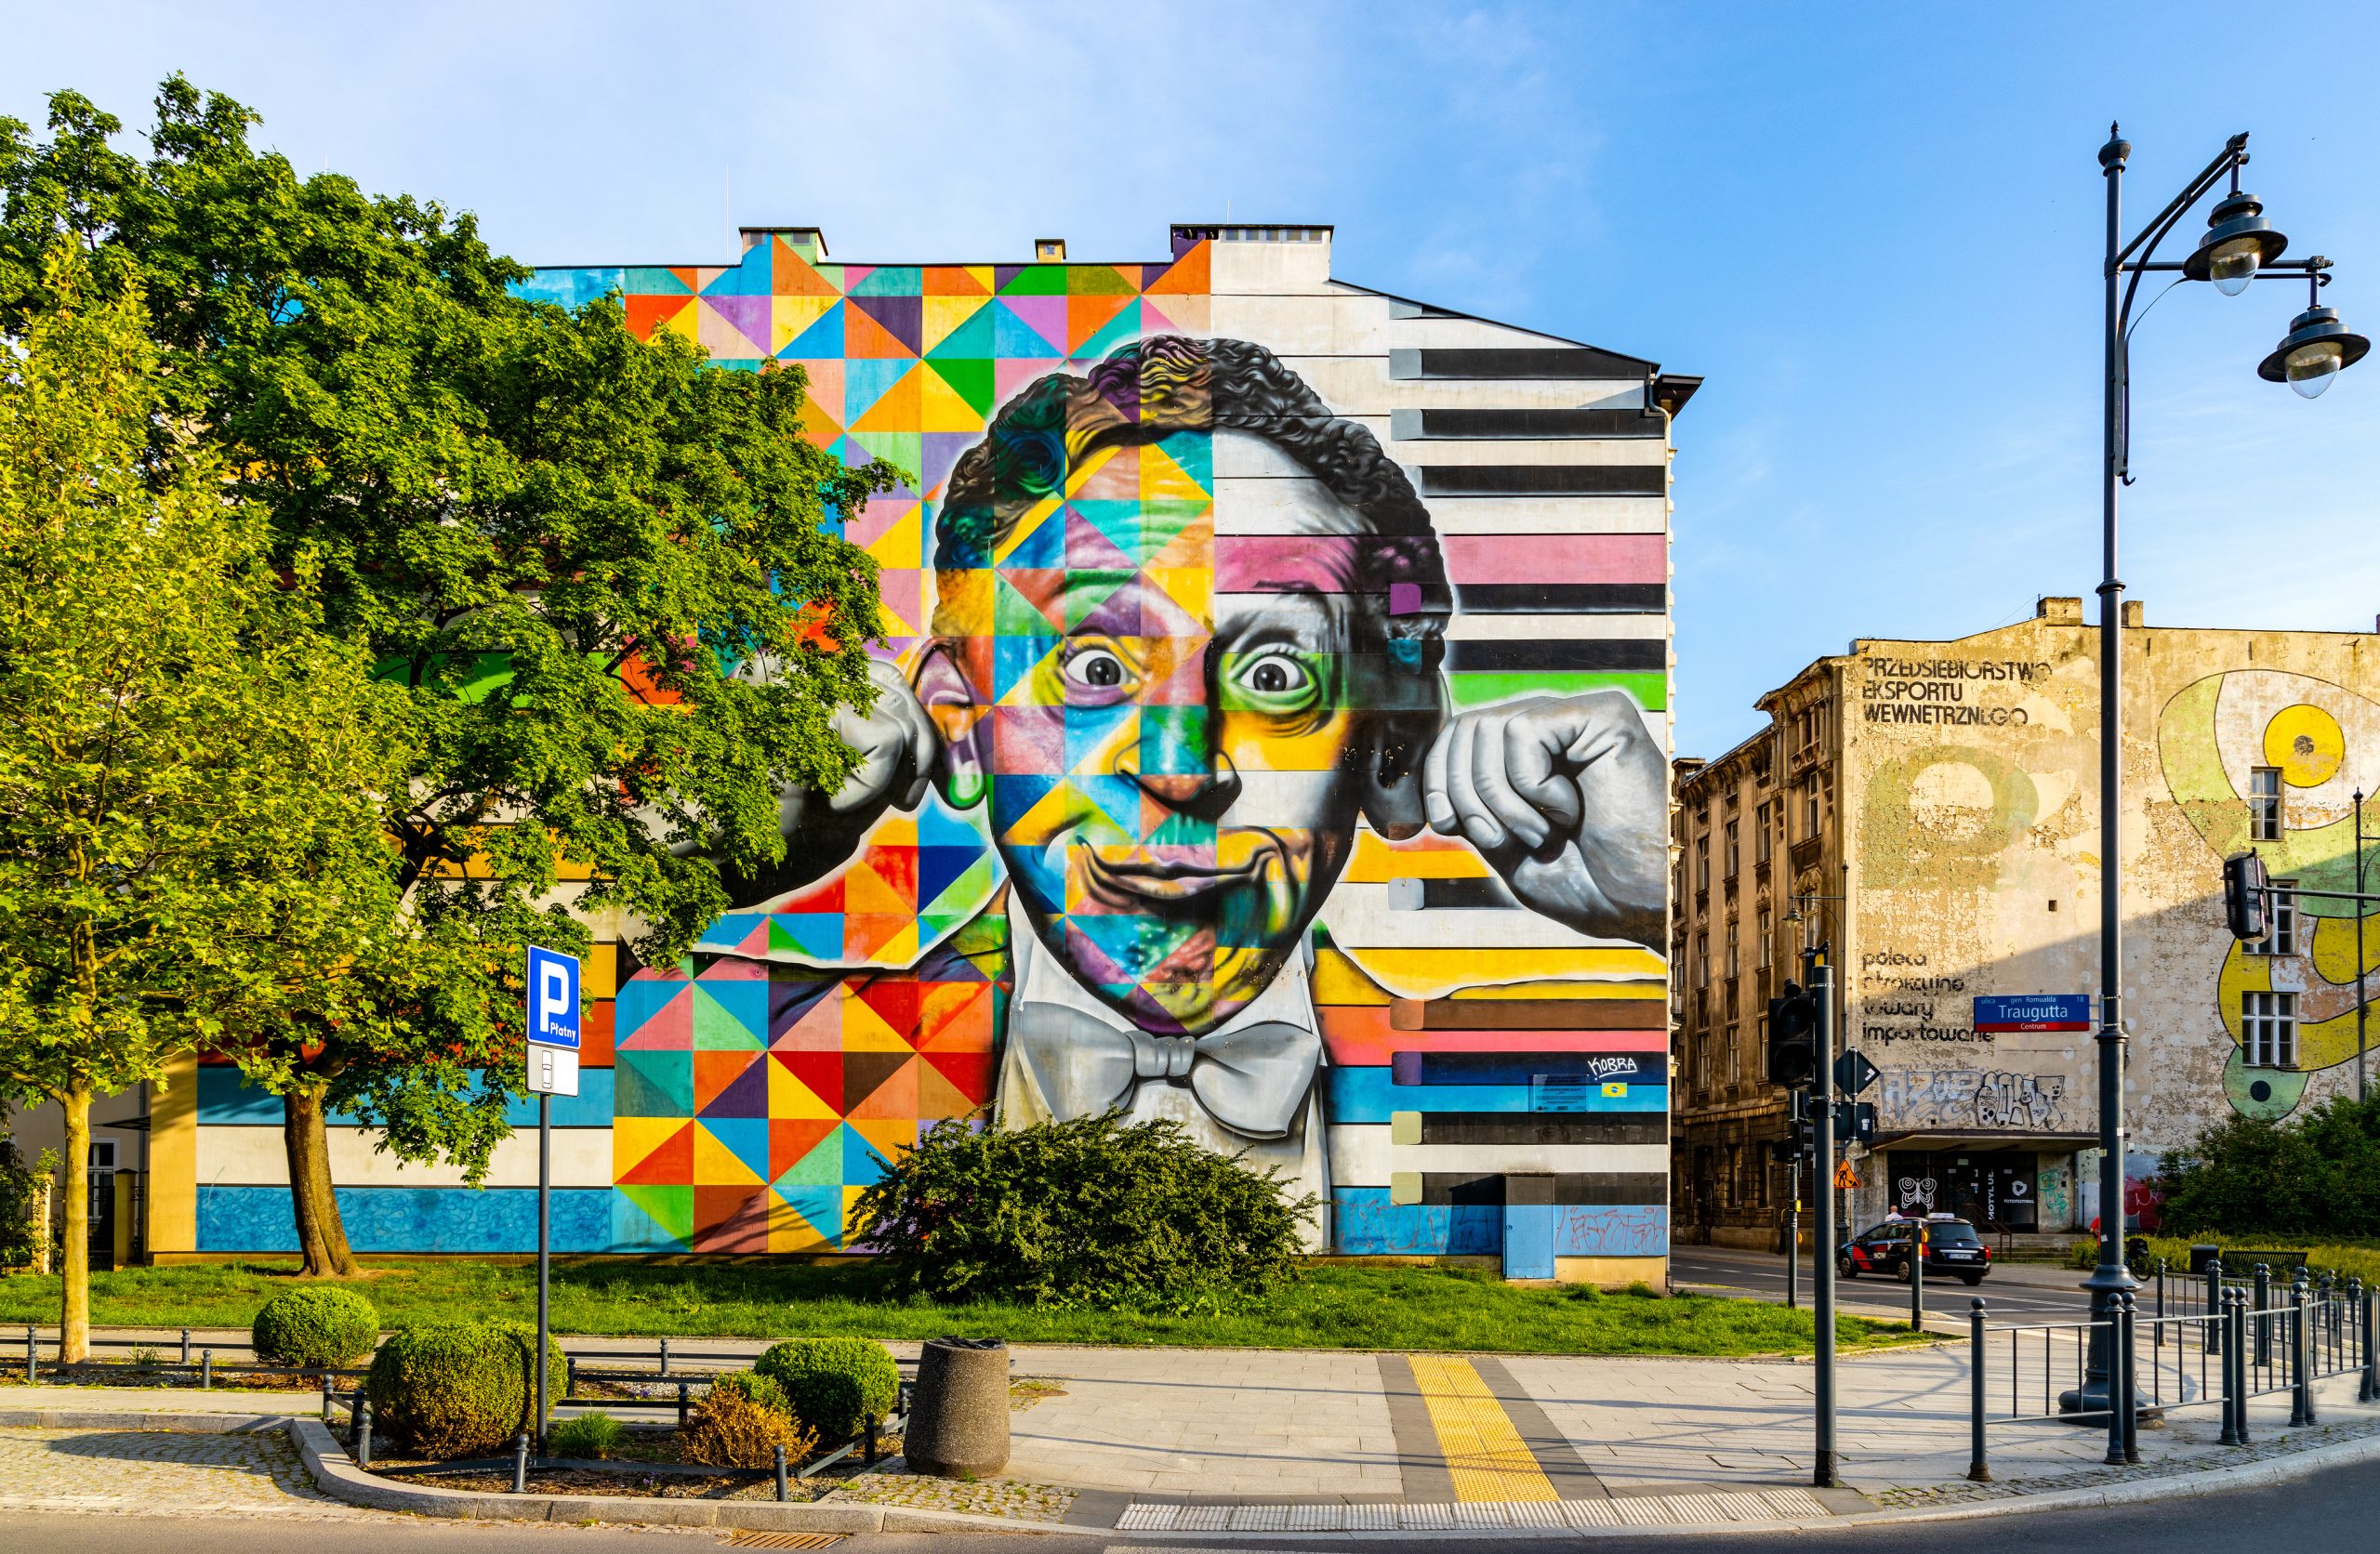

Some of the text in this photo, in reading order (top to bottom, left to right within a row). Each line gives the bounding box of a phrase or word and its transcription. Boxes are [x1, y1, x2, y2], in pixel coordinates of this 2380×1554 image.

[1862, 680, 1963, 702] EKSPORTU
[539, 959, 570, 1033] P
[1998, 1005, 2069, 1021] Traugutta
[549, 1021, 576, 1042] Płatny
[1587, 1057, 1638, 1076] KOBRA
